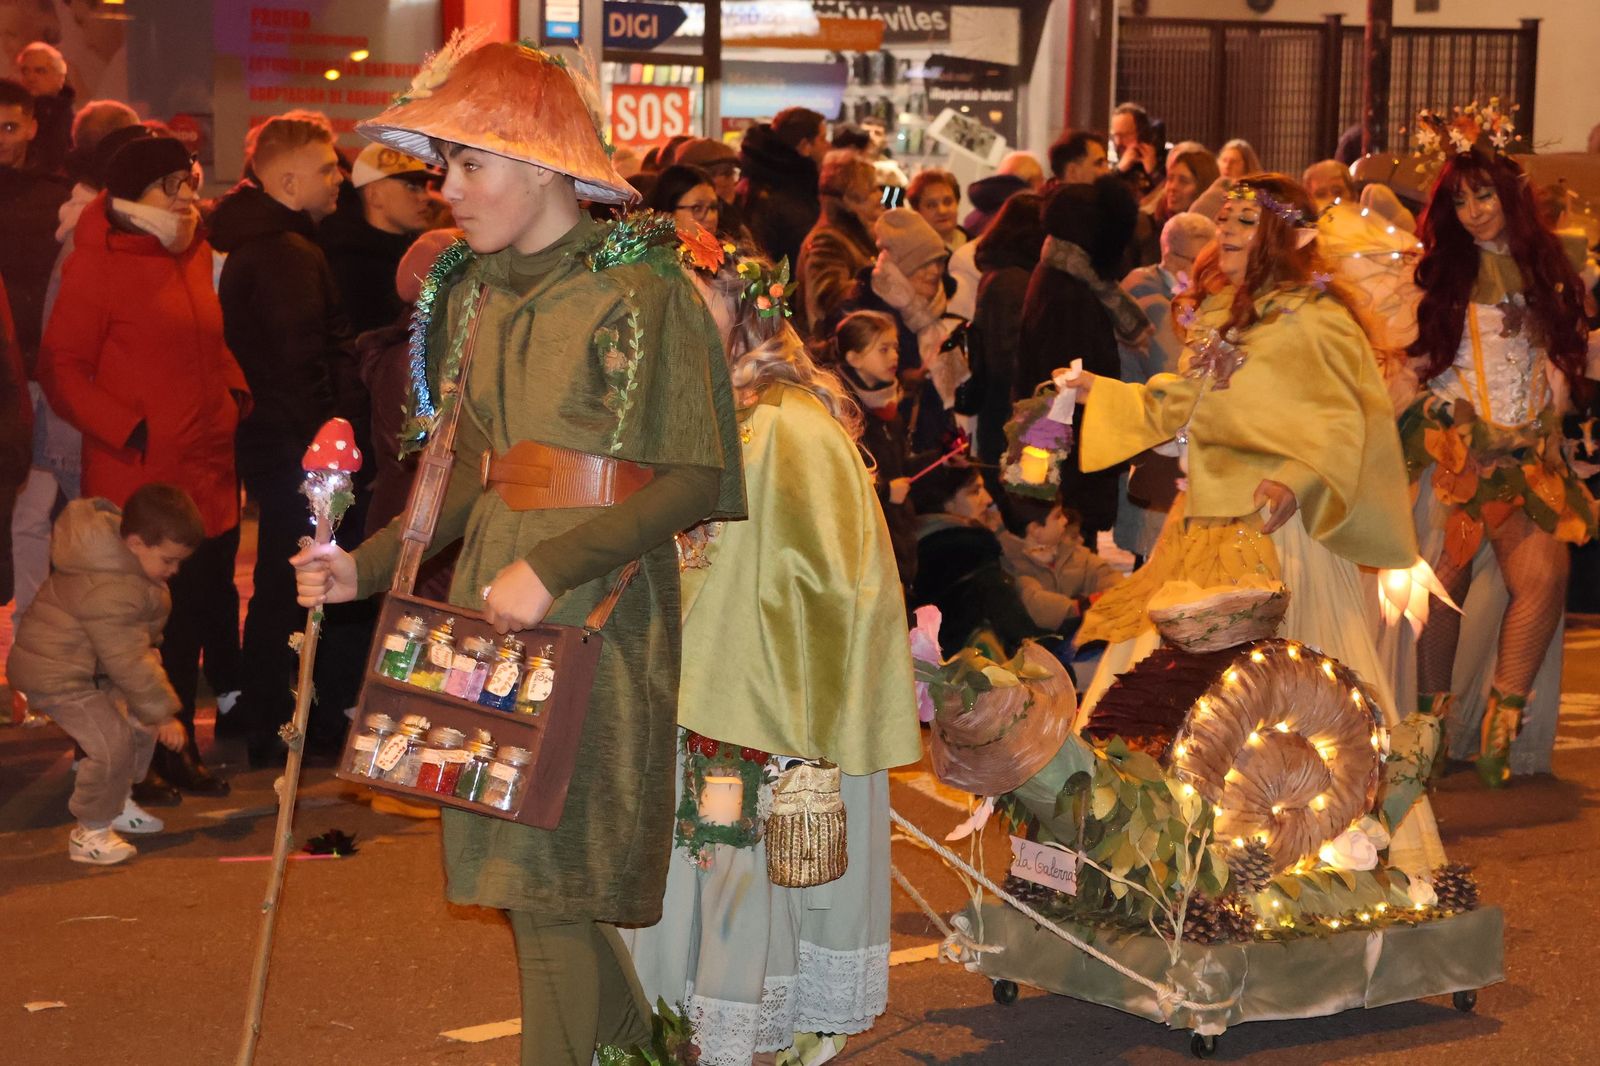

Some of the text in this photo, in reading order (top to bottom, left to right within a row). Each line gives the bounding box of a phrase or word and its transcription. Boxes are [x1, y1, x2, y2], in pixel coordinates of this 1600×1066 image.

[608, 12, 659, 39] DIGI
[616, 92, 684, 141] SOS
[1016, 842, 1032, 870] La
